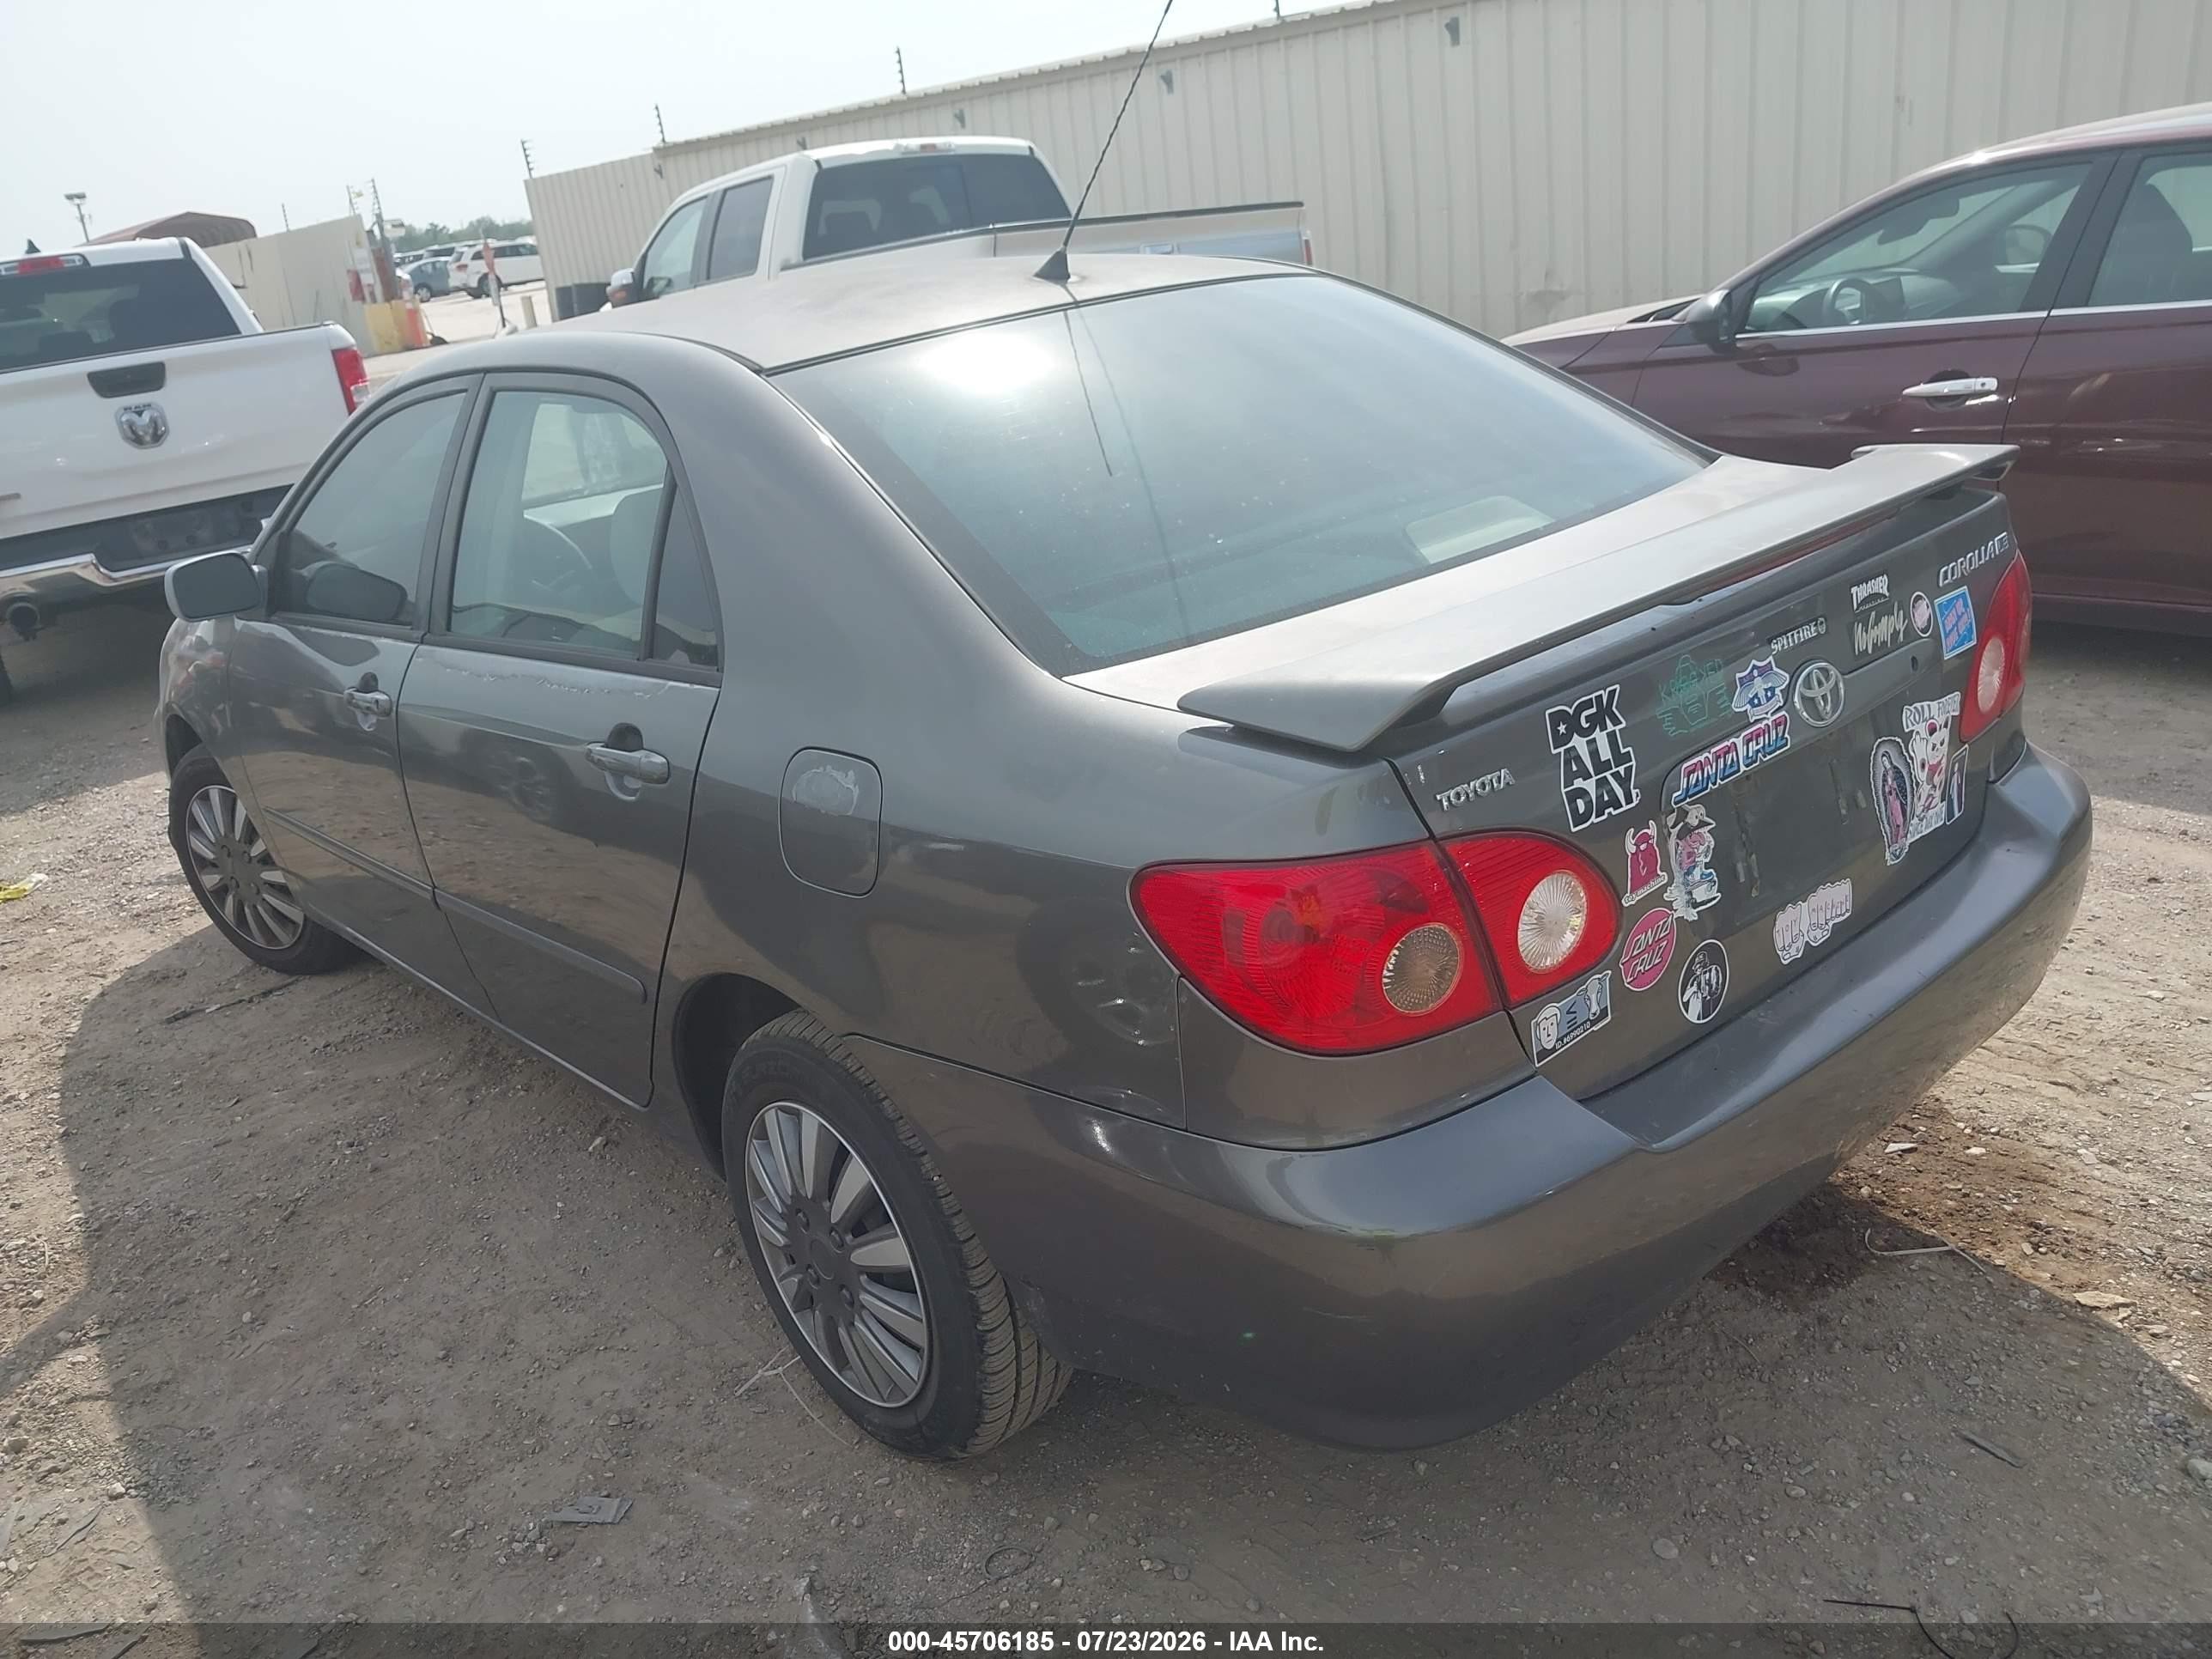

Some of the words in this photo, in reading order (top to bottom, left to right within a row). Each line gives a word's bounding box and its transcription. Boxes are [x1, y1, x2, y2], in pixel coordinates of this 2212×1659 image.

[1939, 541, 1994, 587] COROLLA
[1850, 574, 1889, 611] THRASHER
[1771, 624, 1818, 655] SPITFIRE
[1547, 688, 1625, 751] DGK
[1904, 703, 1935, 729] ROLL
[1563, 728, 1633, 787] ALL
[1674, 741, 1740, 805] SANTA
[1742, 713, 1789, 768] CRUZ
[1437, 769, 1516, 811] TOYOTA
[1564, 763, 1636, 830] DAY
[1624, 890, 1638, 904] toy
[1637, 873, 1666, 897] machine
[1622, 914, 1673, 963] SANTA
[1626, 940, 1668, 983] CRUZ
